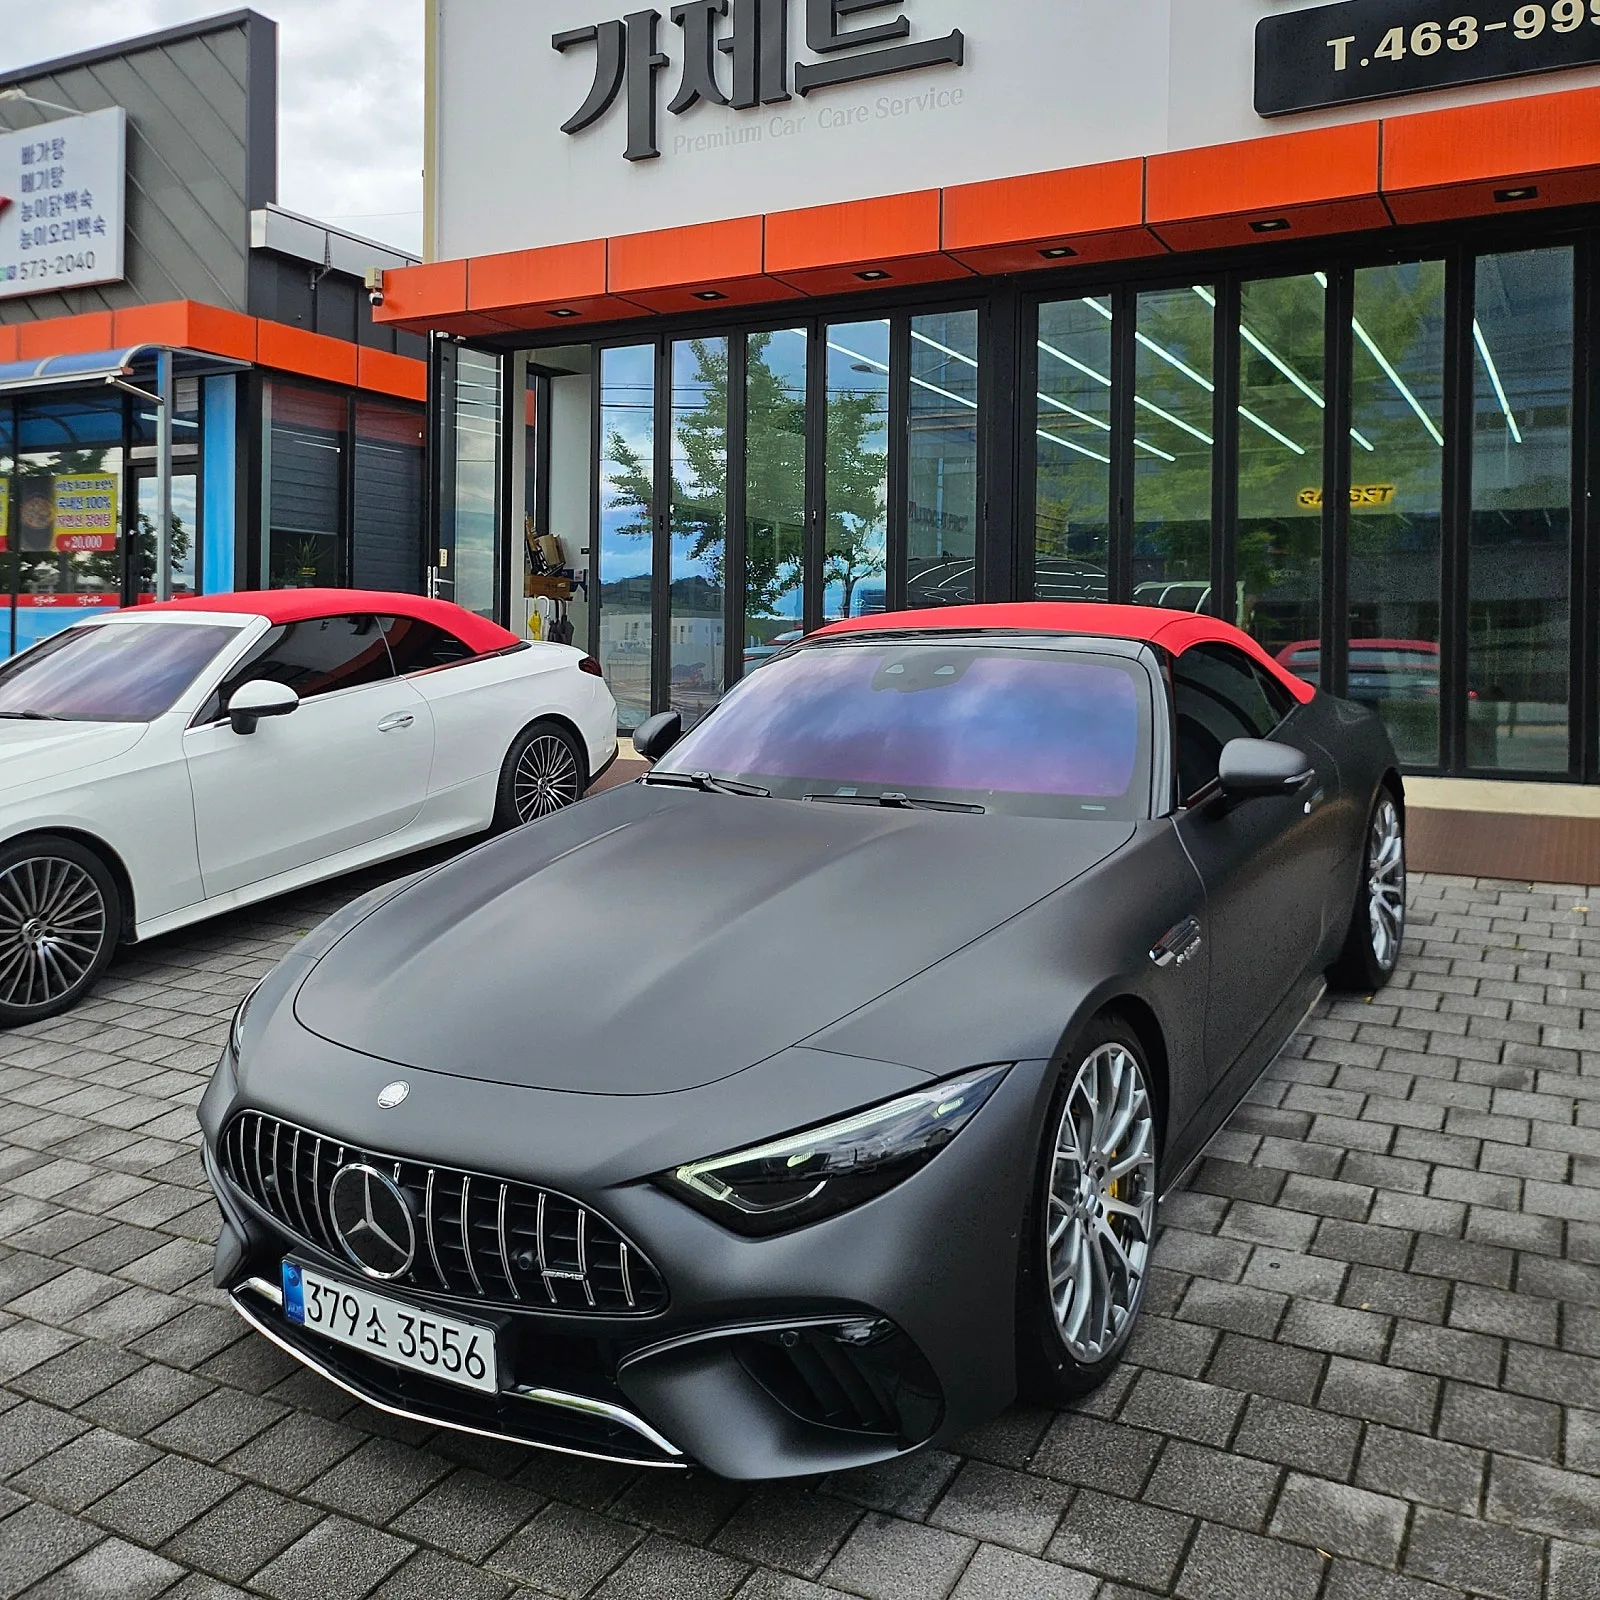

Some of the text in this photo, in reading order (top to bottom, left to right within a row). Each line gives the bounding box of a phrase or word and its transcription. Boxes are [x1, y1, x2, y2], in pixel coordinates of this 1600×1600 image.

[672, 85, 966, 155] Premium Car Care Service
[21, 136, 65, 165] 빠가탕
[21, 165, 64, 193] 메기탕
[20, 188, 94, 222] 능이닭백숙
[19, 214, 107, 250] 능이오리백숙
[20, 250, 96, 280] 573-2040
[86, 495, 111, 509] 100%
[1300, 487, 1393, 504] GGET
[397, 1311, 486, 1380] 3556
